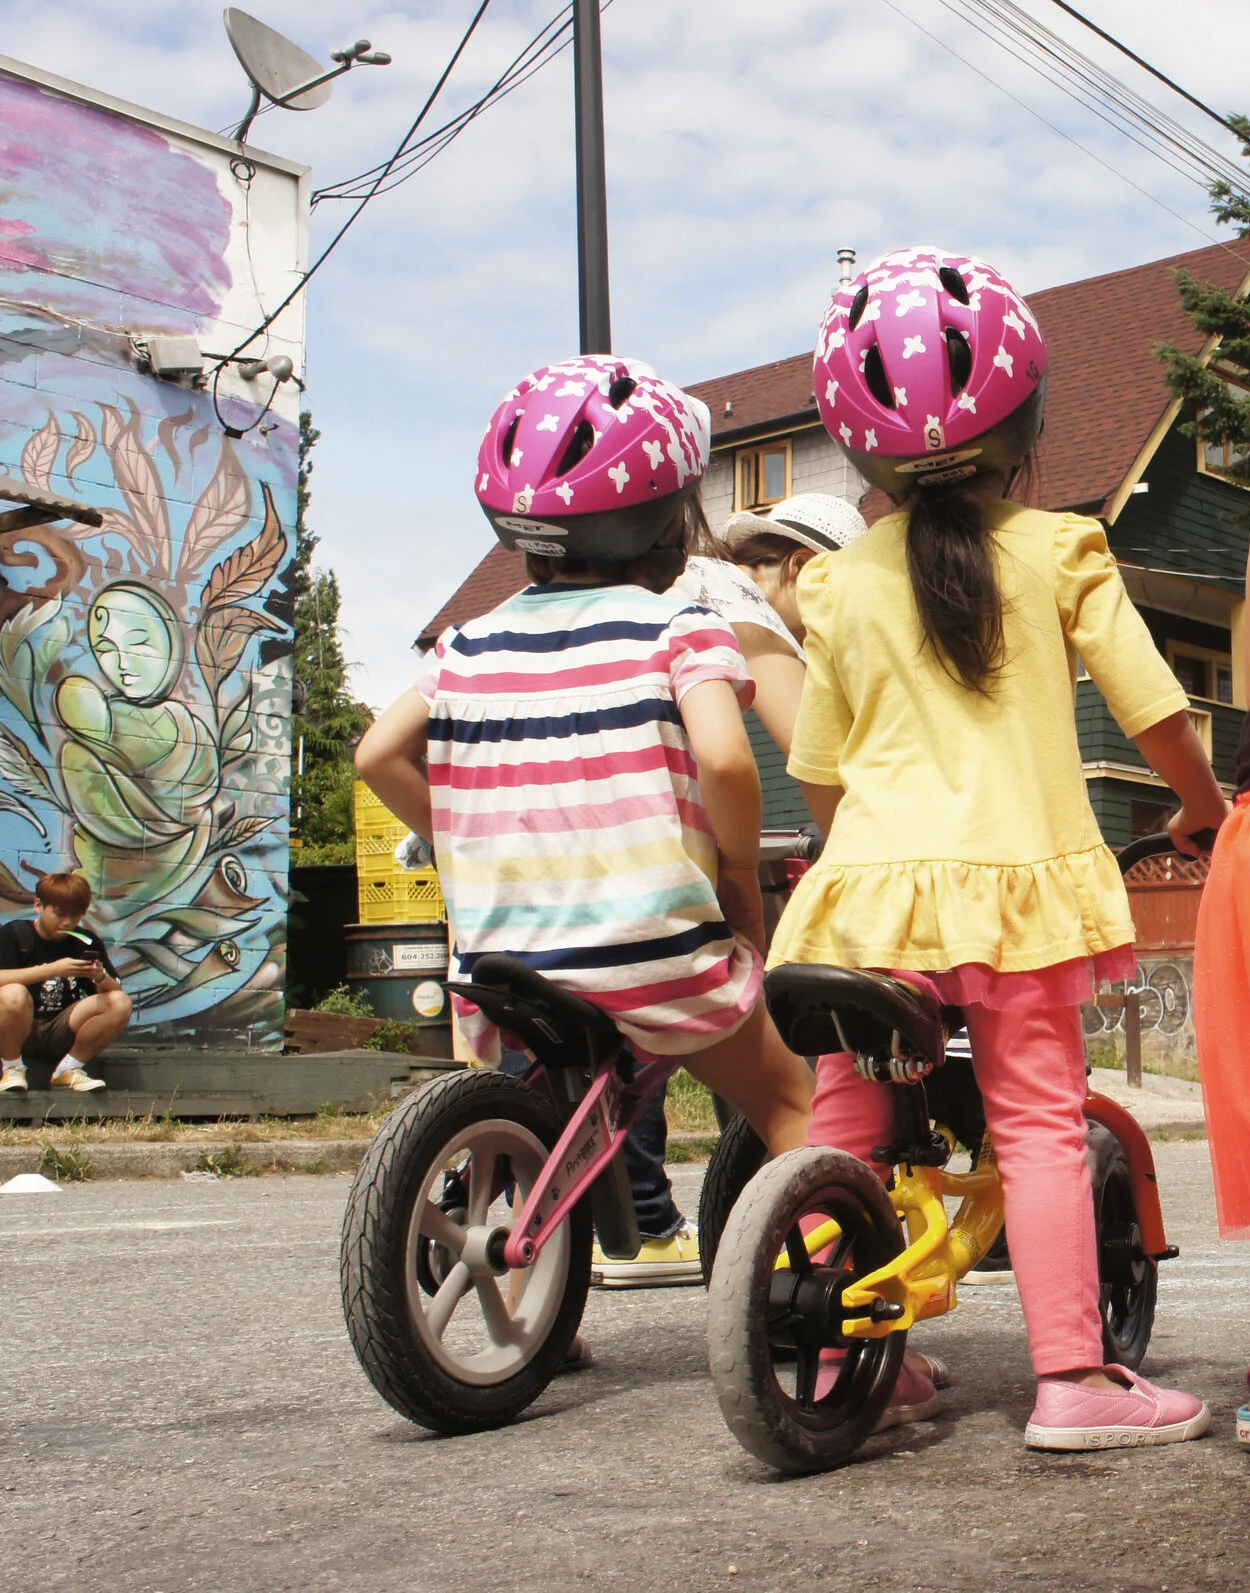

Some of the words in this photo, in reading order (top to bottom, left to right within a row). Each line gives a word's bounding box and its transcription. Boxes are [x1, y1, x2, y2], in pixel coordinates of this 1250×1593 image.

[928, 428, 941, 448] S
[516, 495, 527, 513] S
[505, 520, 544, 531] MET
[1086, 1433, 1161, 1447] SPORT
